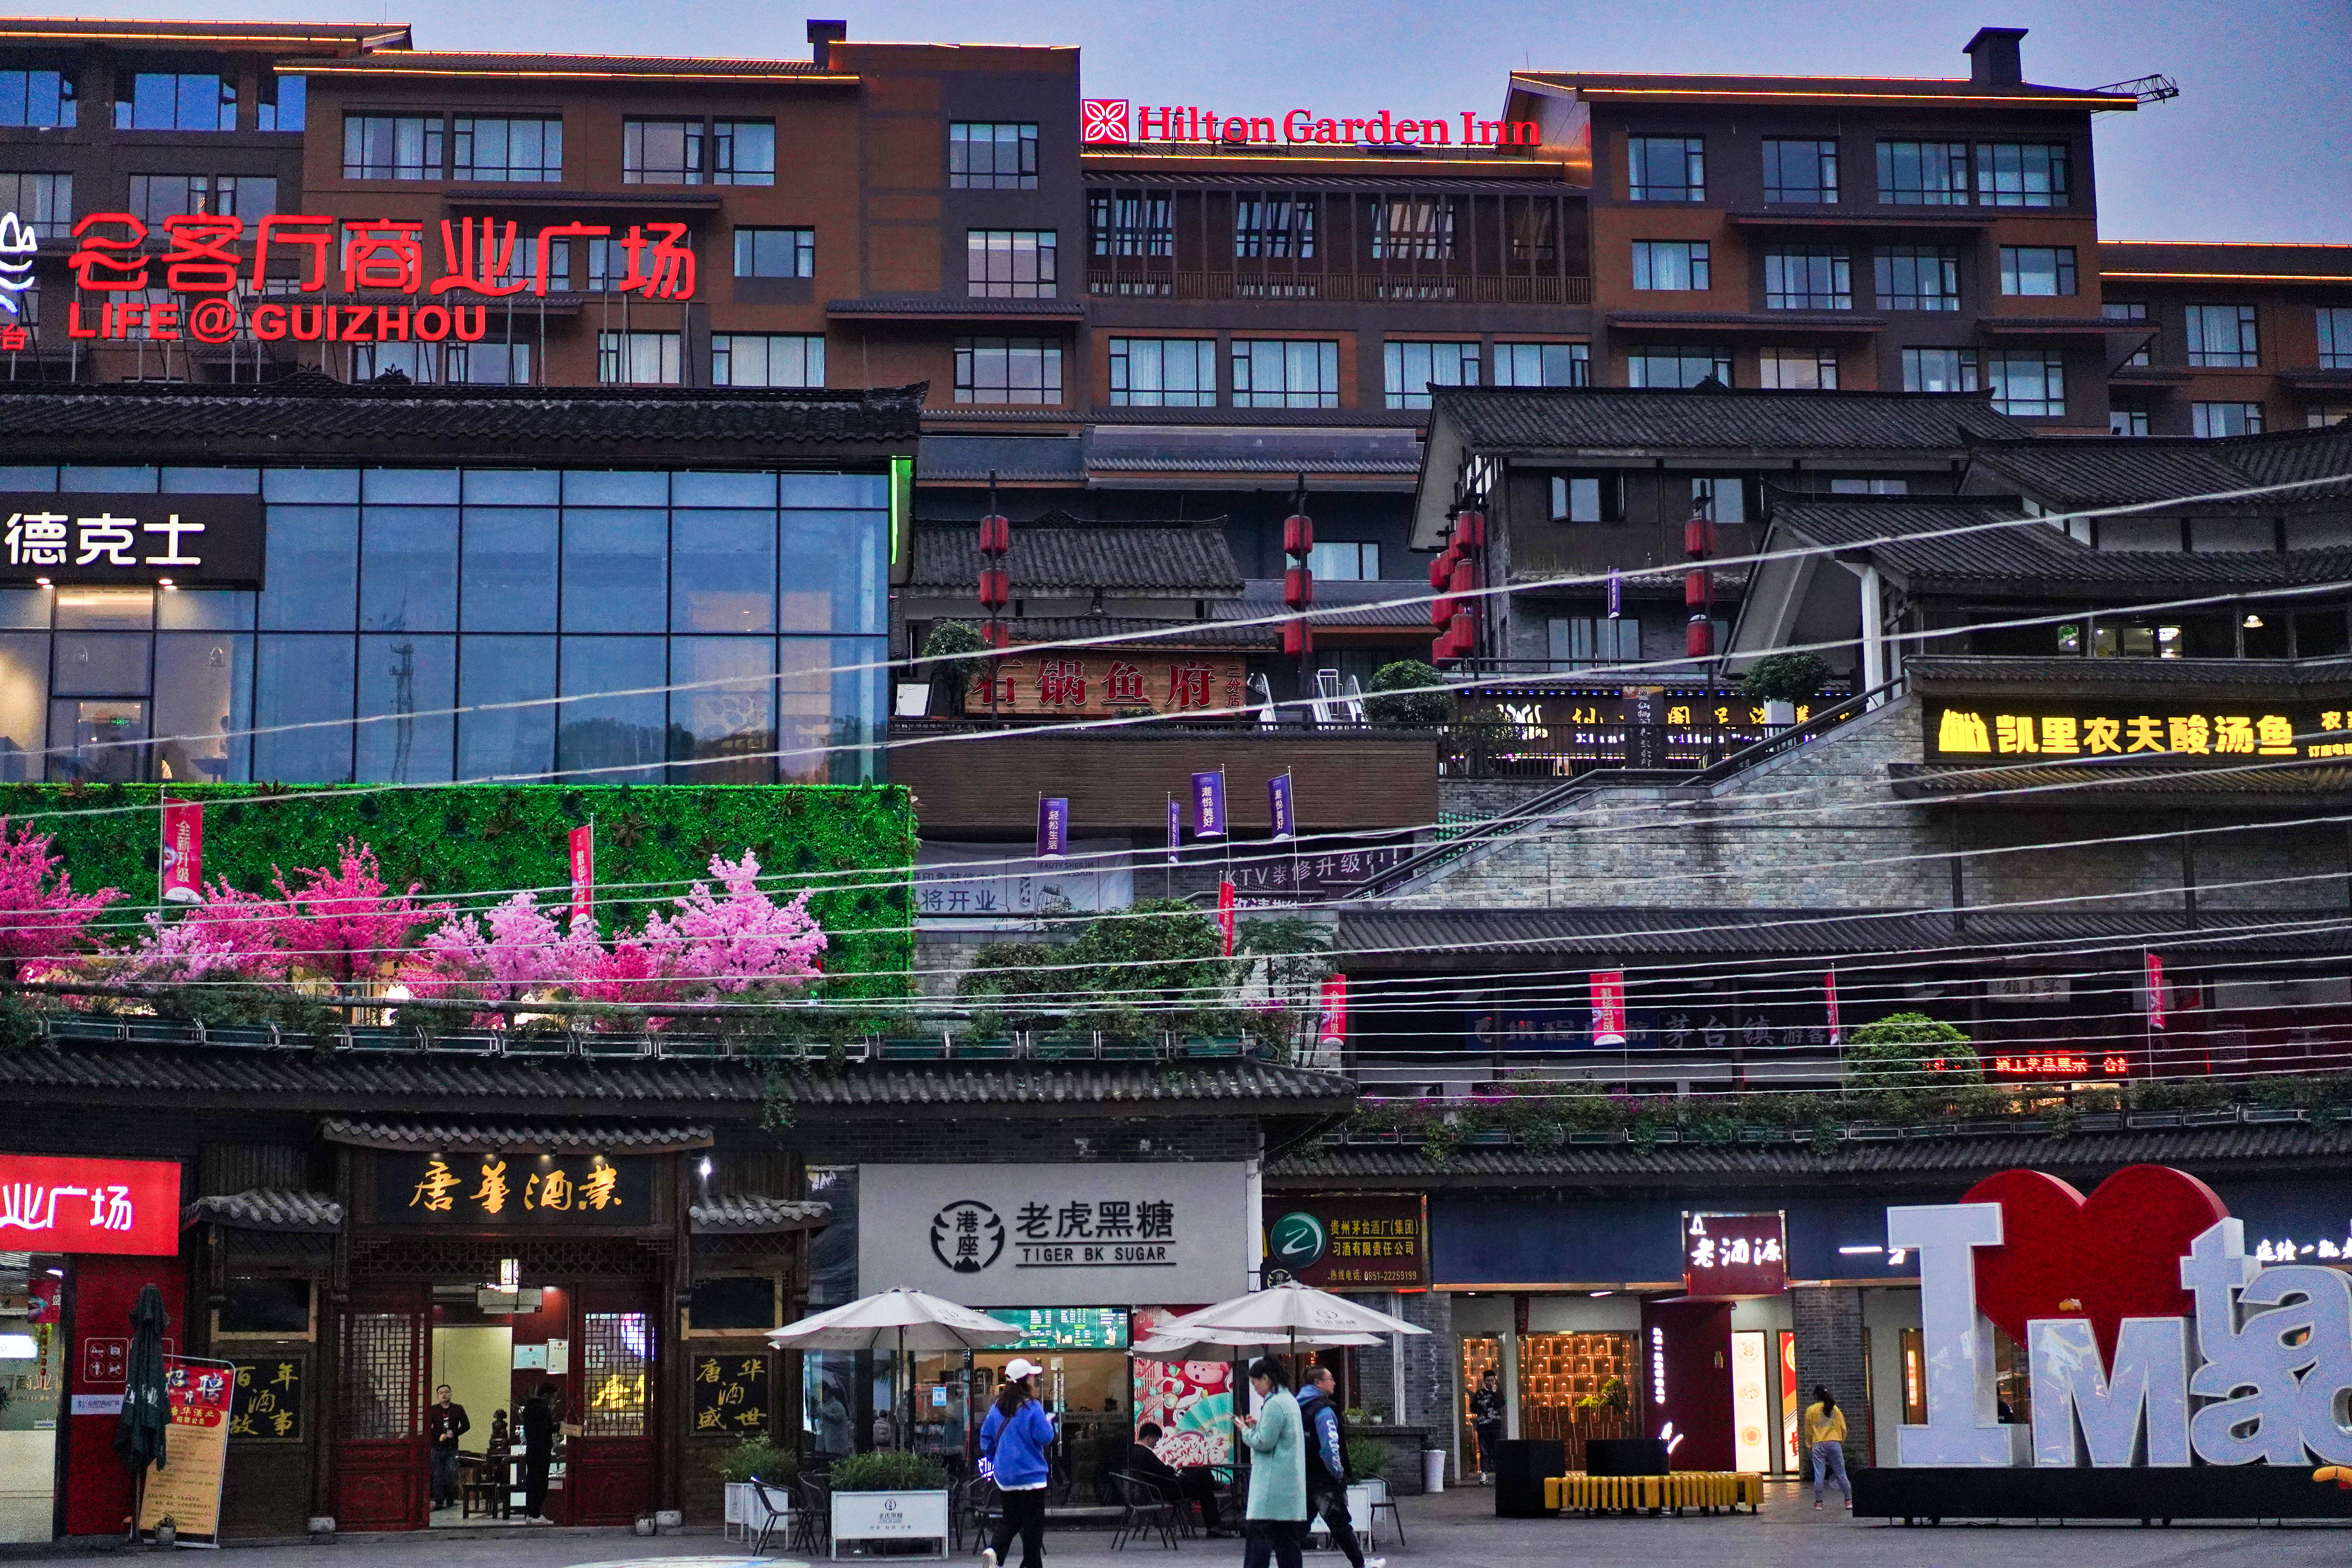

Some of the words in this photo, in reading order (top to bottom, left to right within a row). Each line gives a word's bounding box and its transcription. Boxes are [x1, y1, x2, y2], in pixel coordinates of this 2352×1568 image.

[1139, 105, 1276, 142] Hilton
[1284, 109, 1452, 145] Garden
[1461, 111, 1543, 145] Inn
[69, 212, 697, 300] 会客厅商业广场
[0, 322, 27, 350] 台
[69, 302, 179, 339] LIFE
[190, 298, 238, 344] @
[251, 303, 486, 342] GUIZHOU
[5, 512, 205, 565] 德克士
[972, 658, 1216, 707] 石锅鱼府
[1227, 664, 1241, 708] 二分店
[1996, 714, 2297, 755] 凯里农夫酸汤鱼
[912, 889, 996, 912] 将开业
[0, 1183, 132, 1230] 业广场
[1016, 1200, 1174, 1239] 老虎黑糖
[1330, 1218, 1418, 1236] 贵州茅台酒厂(集团)
[956, 1210, 979, 1257] 港座
[1023, 1247, 1073, 1261] TIGER
[1084, 1246, 1104, 1261] BK
[1115, 1246, 1167, 1261] SUGAR
[1332, 1241, 1414, 1256] 习酒有限责任公司
[1691, 1238, 1782, 1268] 老酒源
[1364, 1270, 1417, 1281] 0851-22259199
[2180, 1217, 2352, 1364] ta
[1887, 1202, 2013, 1468] I
